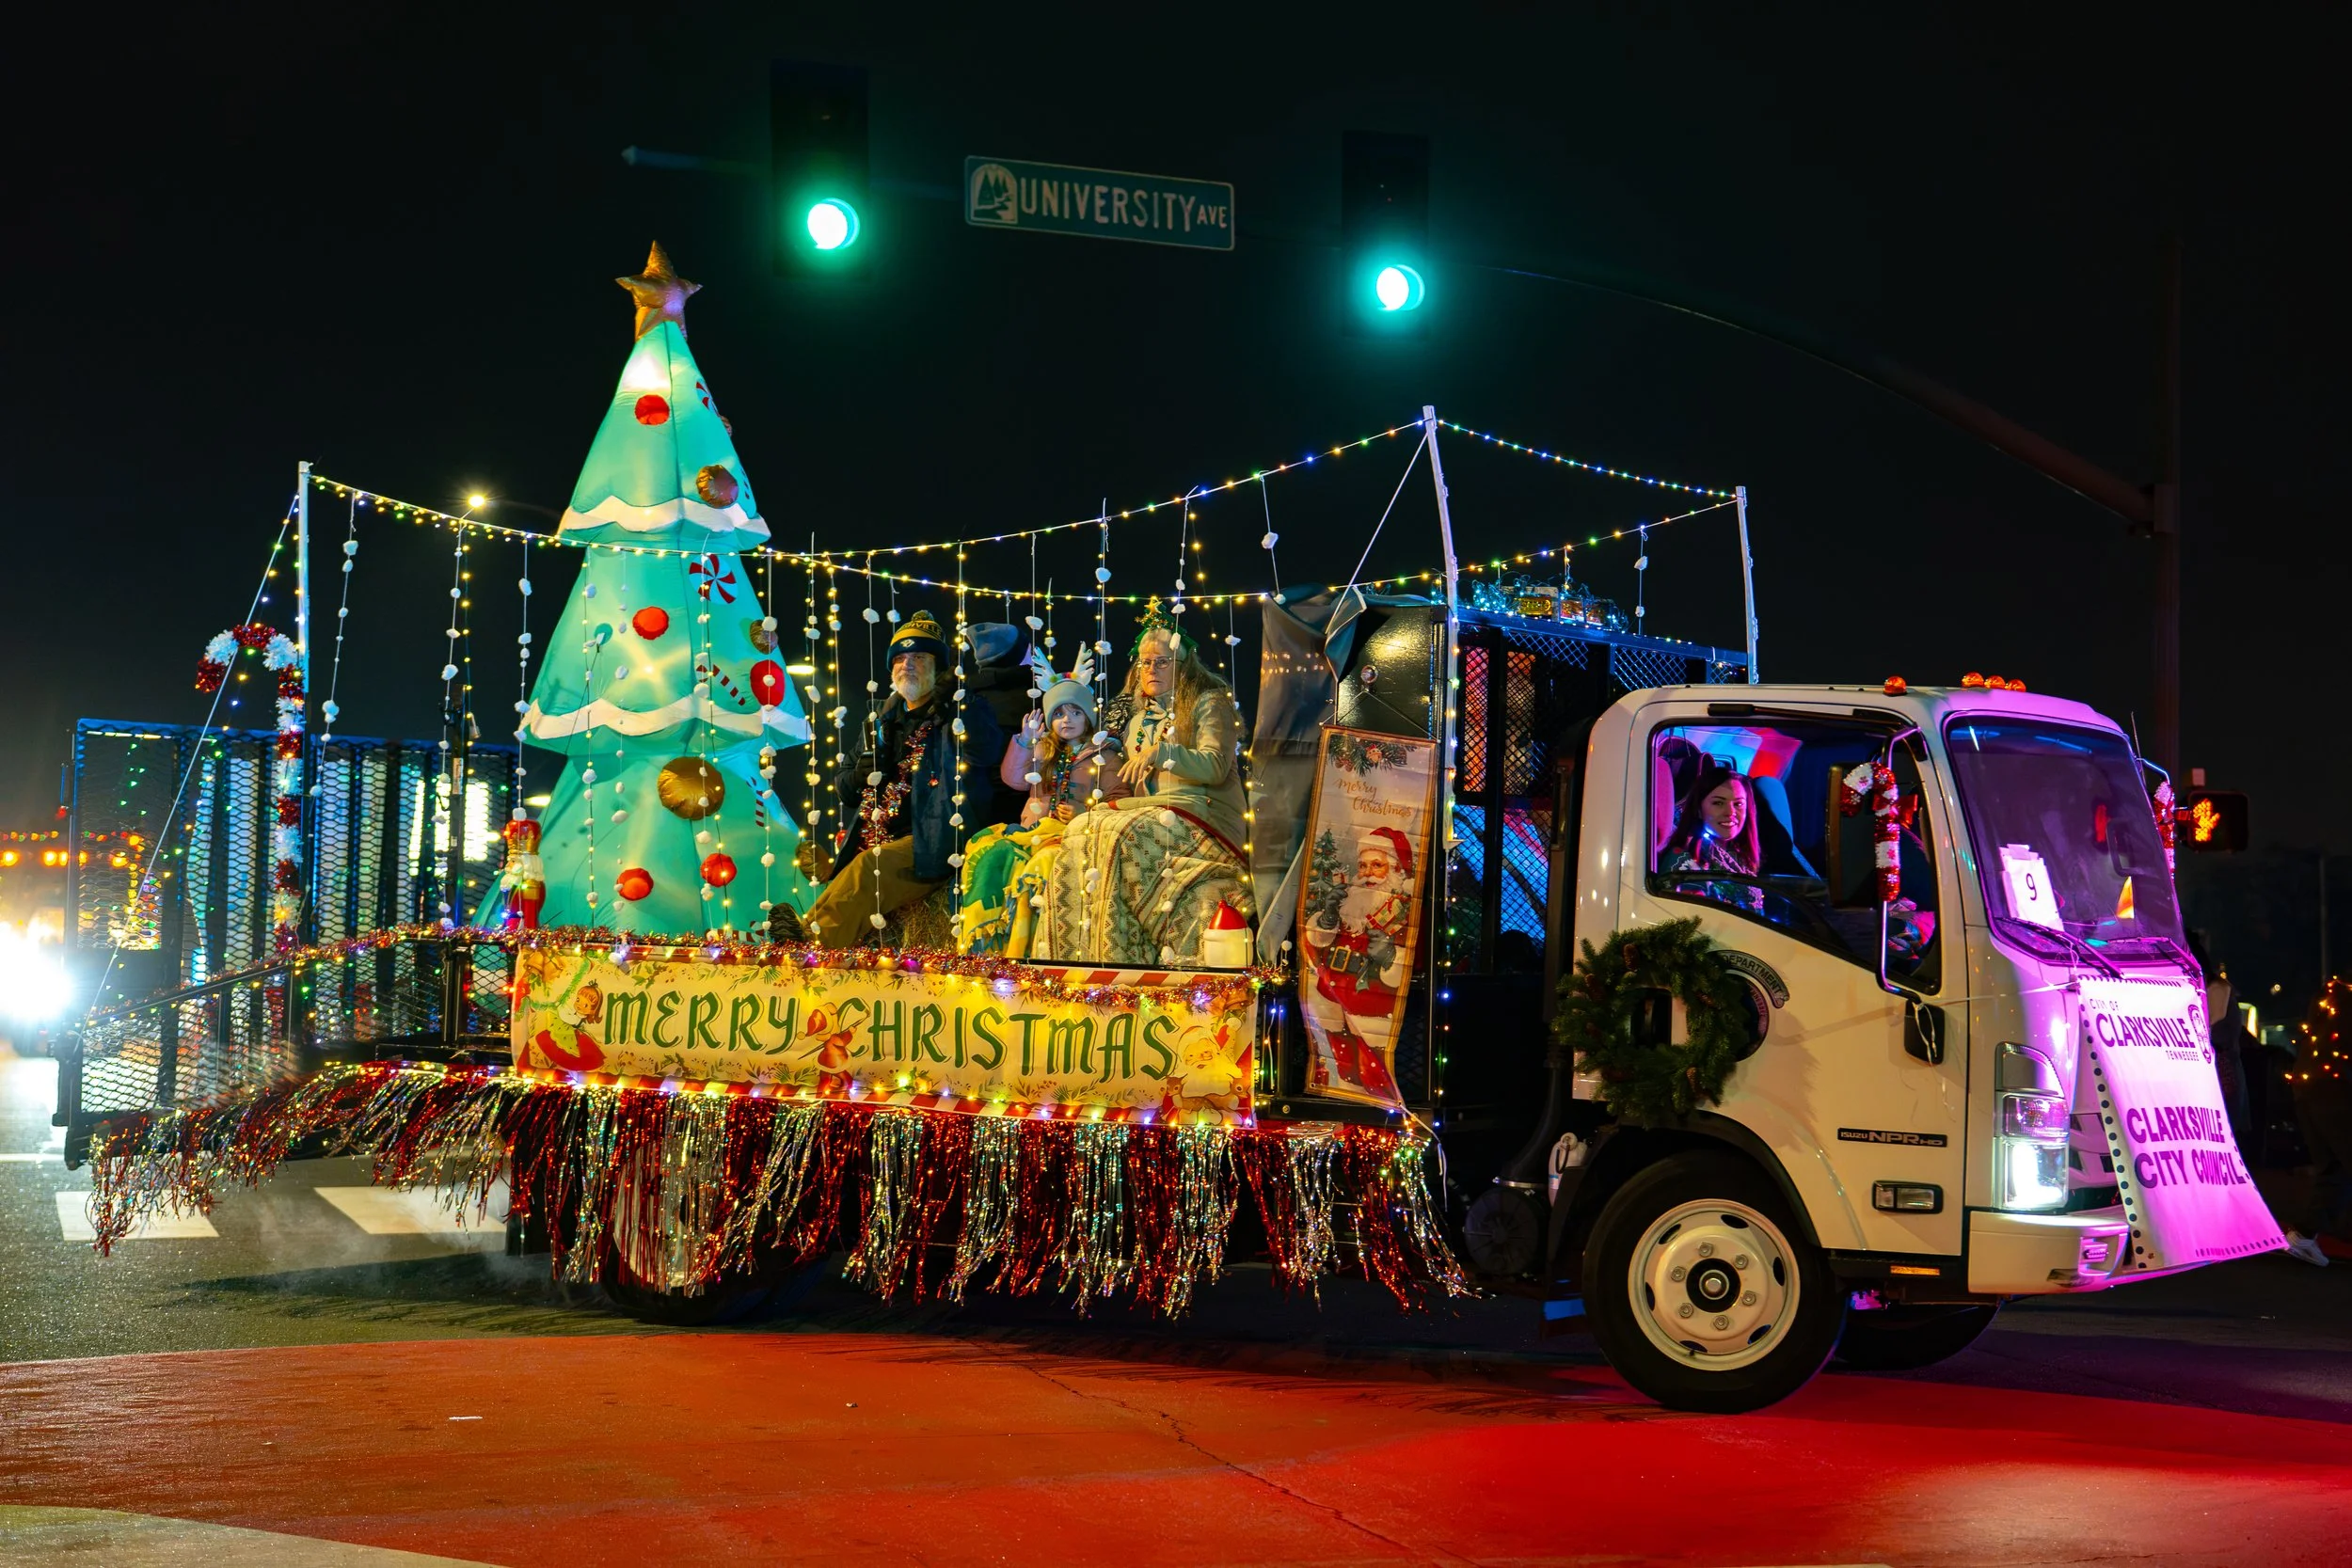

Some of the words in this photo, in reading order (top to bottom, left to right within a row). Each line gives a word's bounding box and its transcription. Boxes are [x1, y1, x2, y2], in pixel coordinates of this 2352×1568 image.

[1020, 177, 1196, 232] UNIVERSITY
[1197, 204, 1227, 229] AVE
[1353, 796, 1411, 817] Christmas
[2026, 873, 2037, 900] 9
[604, 990, 800, 1055] MERRY
[837, 997, 1180, 1084] CHRISTMAS
[2096, 1013, 2196, 1049] CLARKSVILLE
[2165, 1050, 2200, 1062] TENNESSEE
[1840, 1132, 1868, 1140] ISUZU
[1868, 1132, 1920, 1145] NPR
[2126, 1106, 2225, 1144] CLARKSVILLE
[2134, 1149, 2189, 1189] CITY
[2191, 1148, 2247, 1186] COUNCIL
